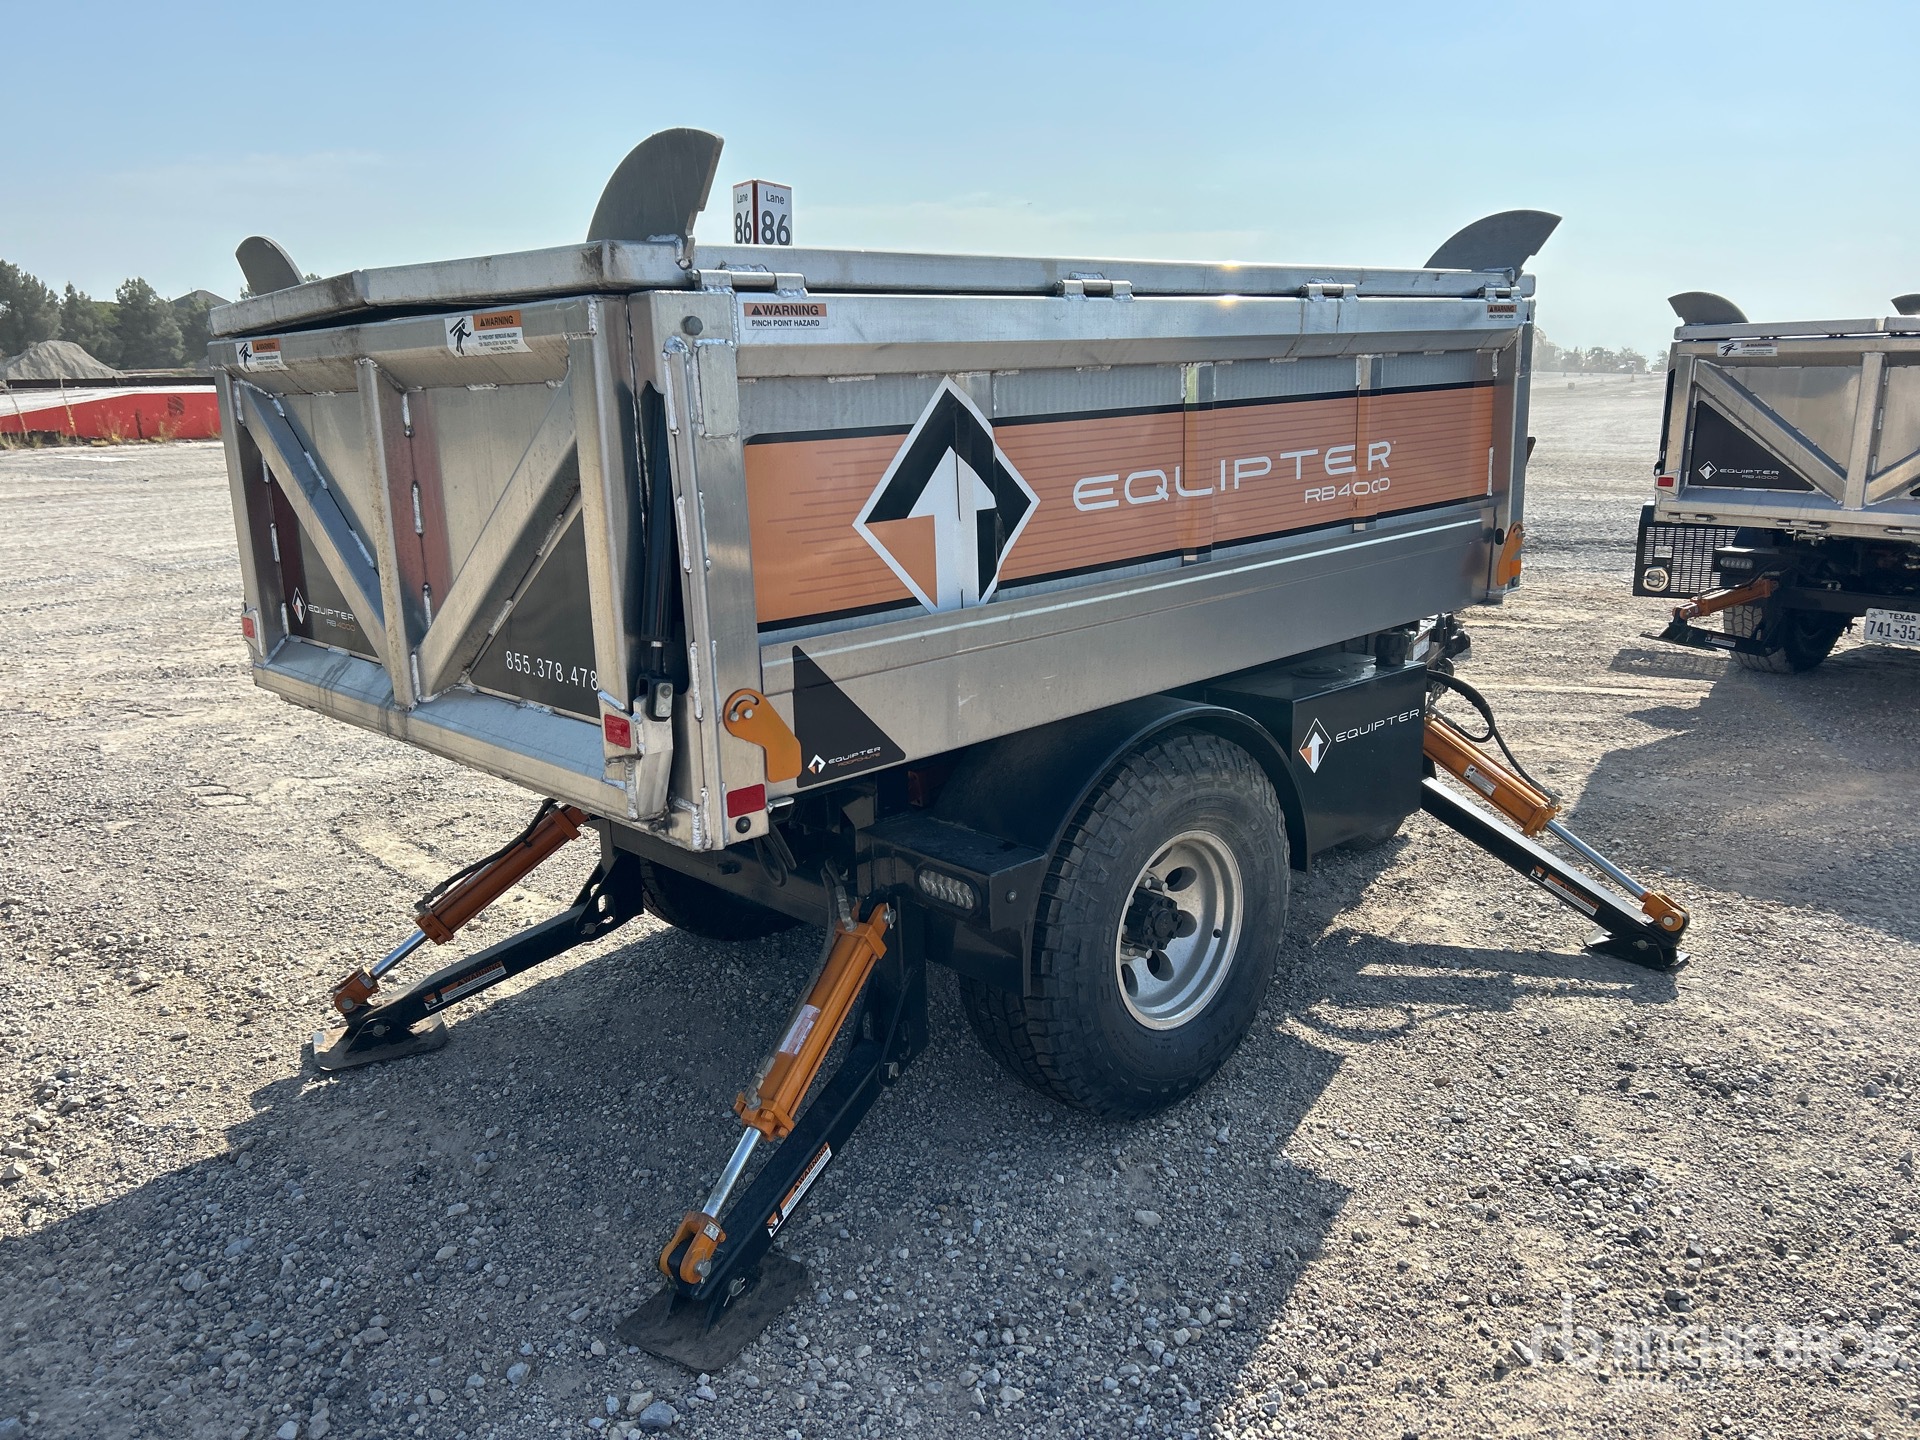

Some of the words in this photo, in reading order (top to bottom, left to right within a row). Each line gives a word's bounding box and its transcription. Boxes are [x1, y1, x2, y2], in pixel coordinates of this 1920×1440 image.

[737, 193, 748, 204] Lane
[765, 190, 785, 205] Lane
[735, 210, 752, 244] 86
[761, 210, 791, 246] 86
[762, 304, 819, 316] WARNING
[485, 315, 514, 327] WARNING
[751, 319, 772, 327] PINCH
[773, 319, 792, 327] POINT
[794, 319, 820, 327] HAZARD
[1072, 441, 1391, 512] EQUIPTER
[307, 604, 355, 622] EQUIPTER
[1888, 612, 1917, 622] TEXAS
[1869, 620, 1892, 637] 741
[1335, 708, 1420, 743] EQUIPTER
[828, 746, 881, 765] EQUIPTER
